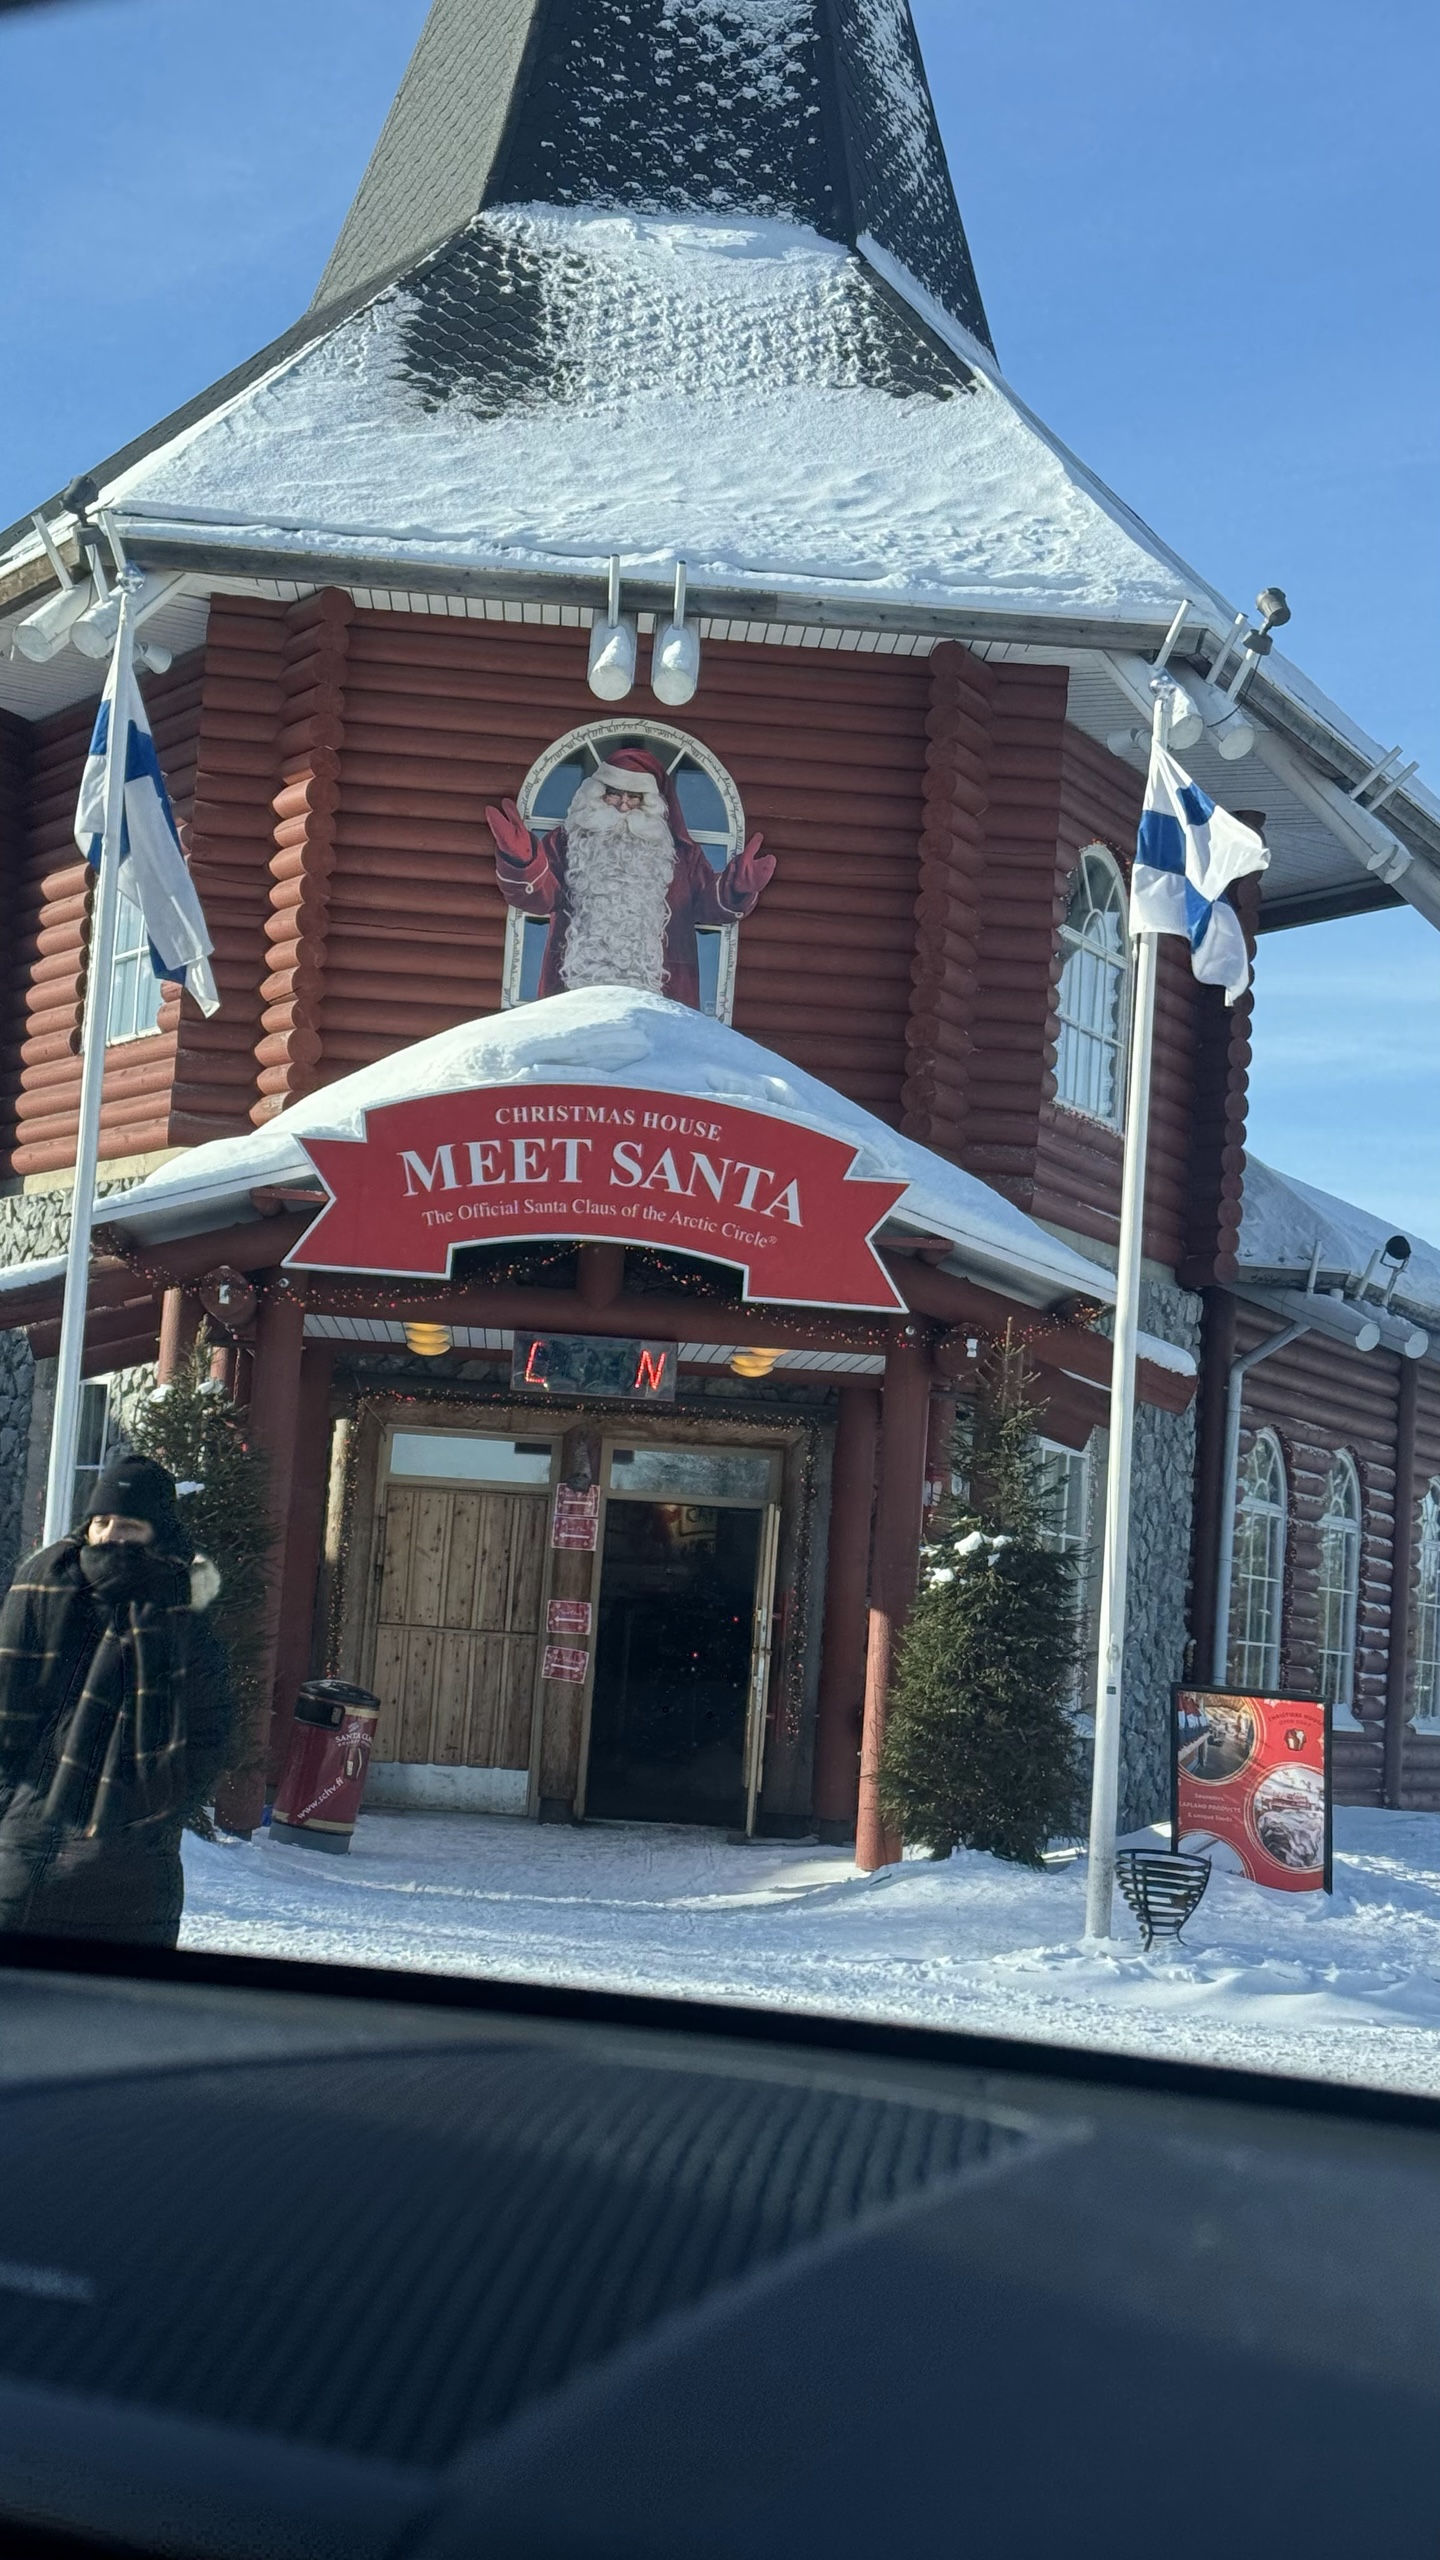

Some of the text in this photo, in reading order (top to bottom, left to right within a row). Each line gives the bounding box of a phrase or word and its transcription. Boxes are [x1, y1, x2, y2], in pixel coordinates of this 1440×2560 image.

[496, 1106, 722, 1141] CHRISTMAS HOUSE
[397, 1138, 805, 1228] MEET SANTA
[421, 1209, 453, 1227] The
[457, 1199, 519, 1220] Official
[523, 1199, 567, 1216] Santa
[572, 1199, 617, 1217] Claus
[620, 1201, 640, 1219] of
[641, 1204, 666, 1223] the
[669, 1209, 717, 1235] Arctic
[335, 1732, 361, 1743] SANTA
[297, 1776, 344, 1819] www.schv.fi
